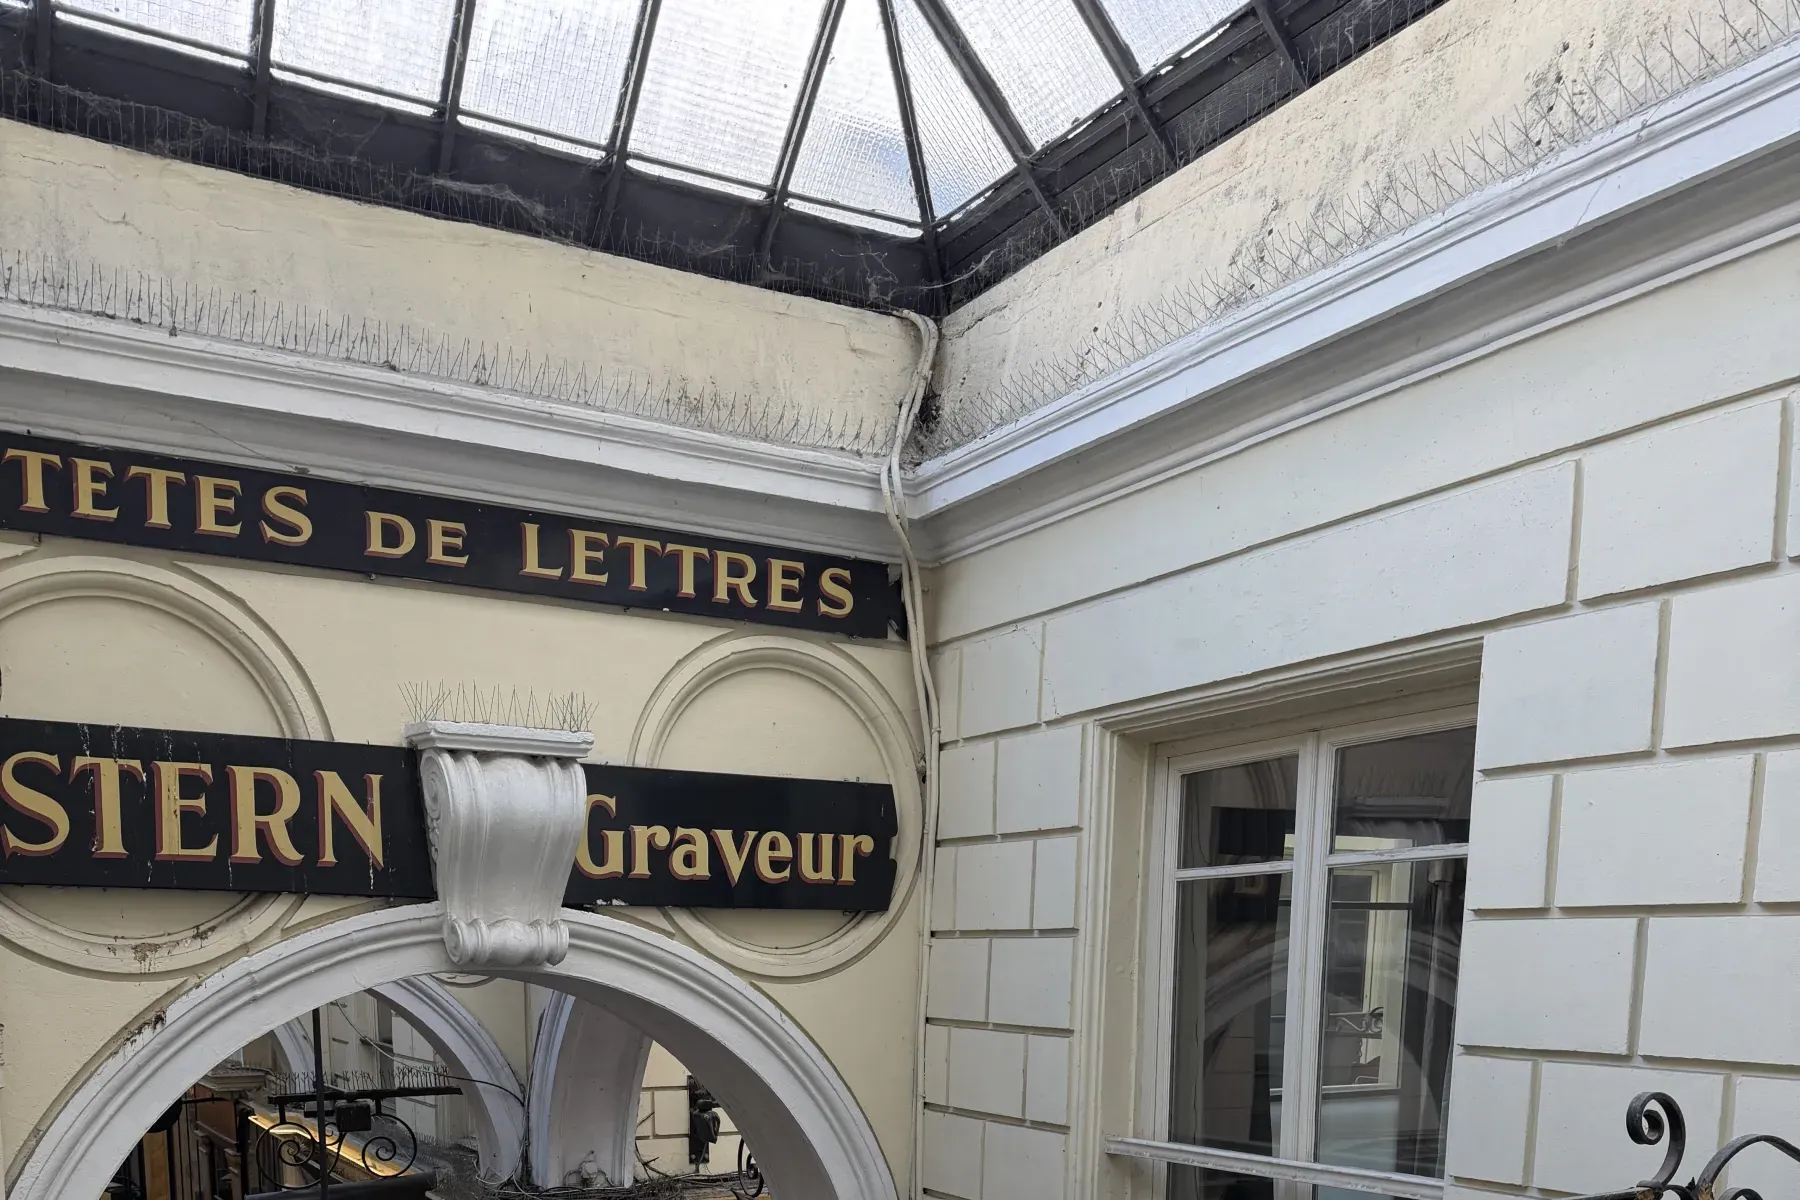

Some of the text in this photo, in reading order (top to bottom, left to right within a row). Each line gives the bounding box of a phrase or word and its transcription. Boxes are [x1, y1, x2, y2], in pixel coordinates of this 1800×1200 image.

[1, 448, 855, 618] TETES DE LETTRES
[0, 751, 875, 888] STERN Graveur
